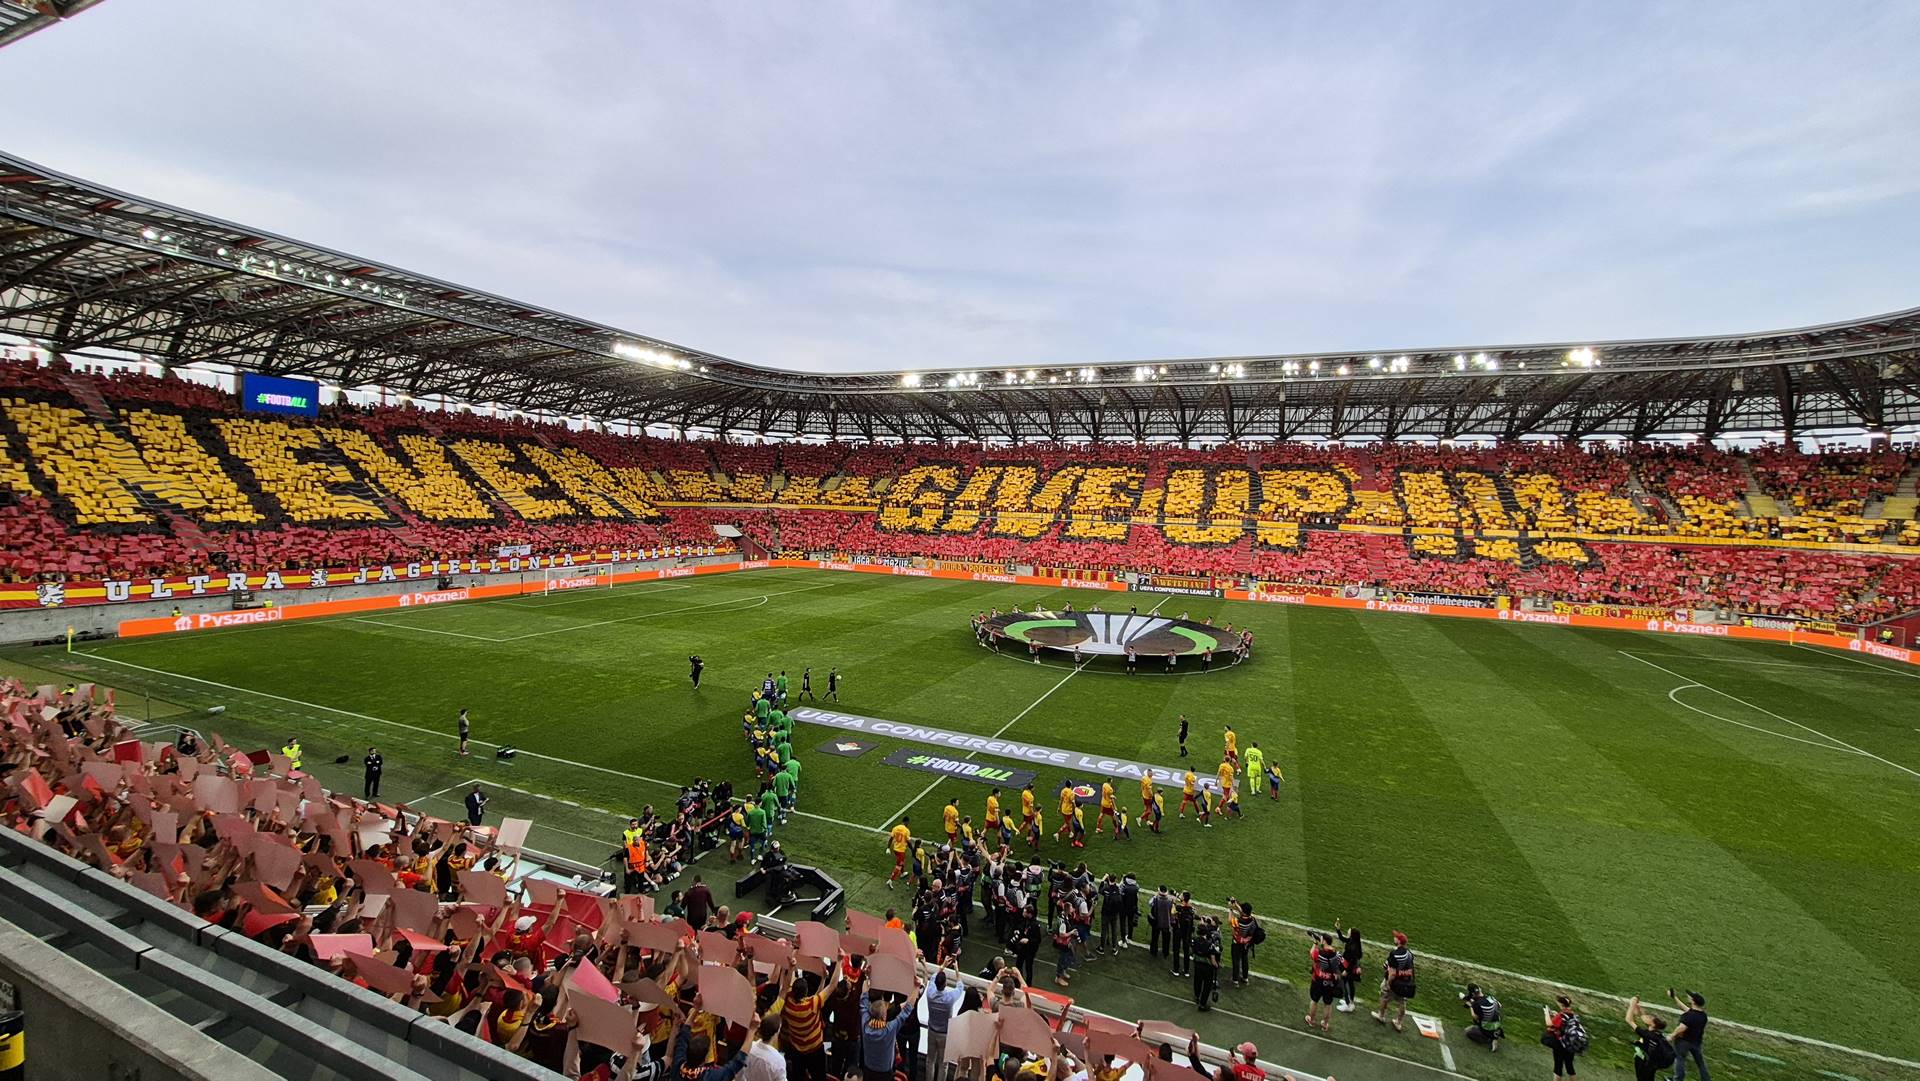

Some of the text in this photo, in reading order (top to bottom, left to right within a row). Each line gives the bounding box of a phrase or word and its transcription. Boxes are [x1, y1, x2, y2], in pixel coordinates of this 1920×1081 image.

[256, 393, 307, 408] #FOOTBALL
[877, 462, 1148, 542] GIVE
[1160, 466, 1354, 550] UP
[103, 571, 285, 601] ULTRA
[353, 553, 576, 584] JAGIELLONIA
[414, 588, 469, 605] Pyszne.pl
[1154, 586, 1189, 595] CONFERENCE
[1190, 588, 1212, 596] LEAGUE
[1379, 601, 1430, 614] Pyszne.pl
[199, 607, 282, 627] Pyszne.pl
[1513, 610, 1570, 625] Pyszne.pl
[1663, 620, 1728, 636] Pyszne.pl
[797, 710, 1218, 790] UEFA CONFERENCE LEAGUE
[906, 755, 1014, 782] #FOOTBALL
